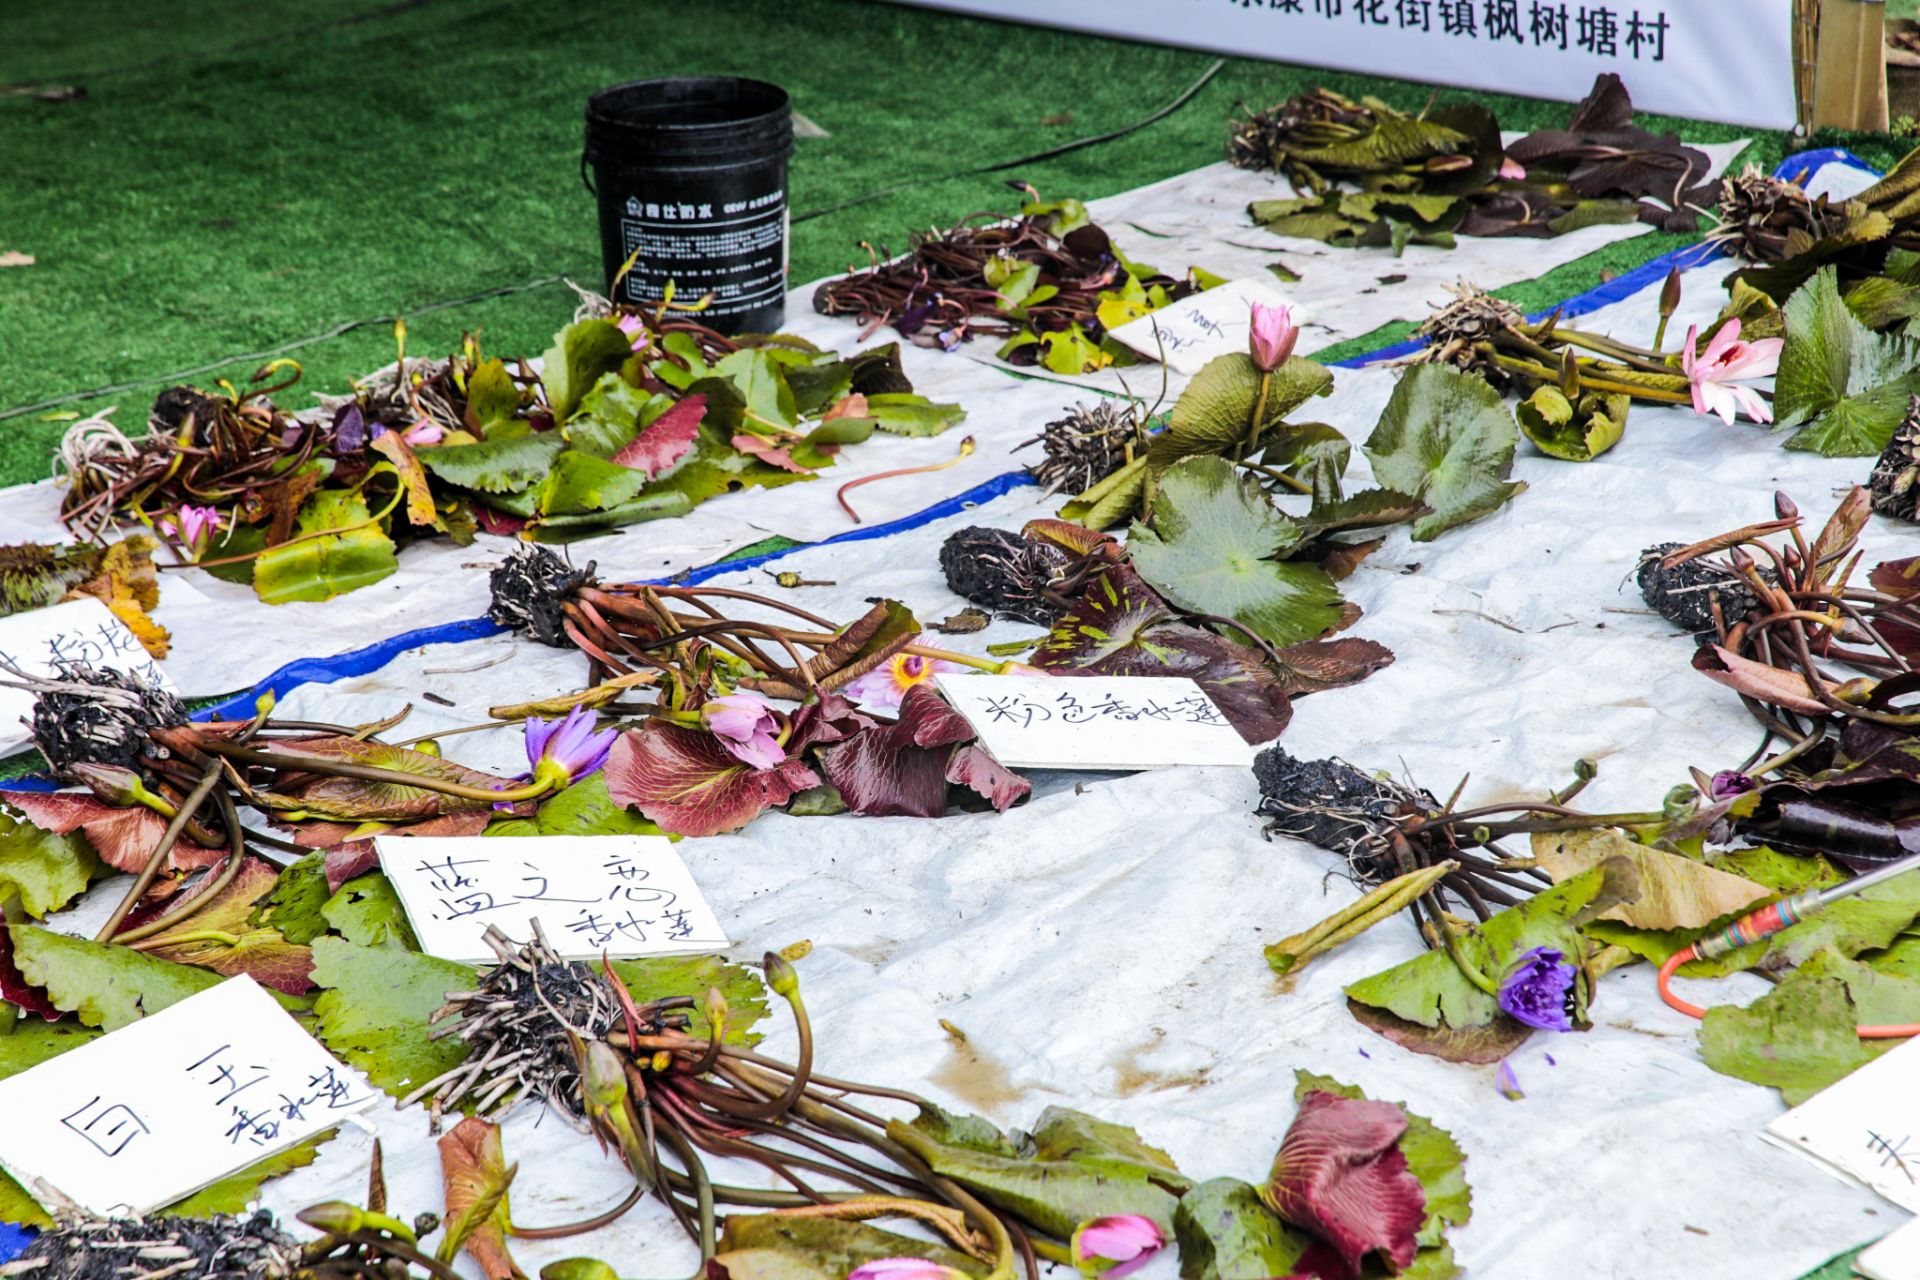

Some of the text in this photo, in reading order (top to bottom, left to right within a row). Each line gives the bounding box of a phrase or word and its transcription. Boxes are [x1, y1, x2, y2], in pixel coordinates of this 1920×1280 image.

[1230, 0, 1671, 61] 花街镇枫树塘村
